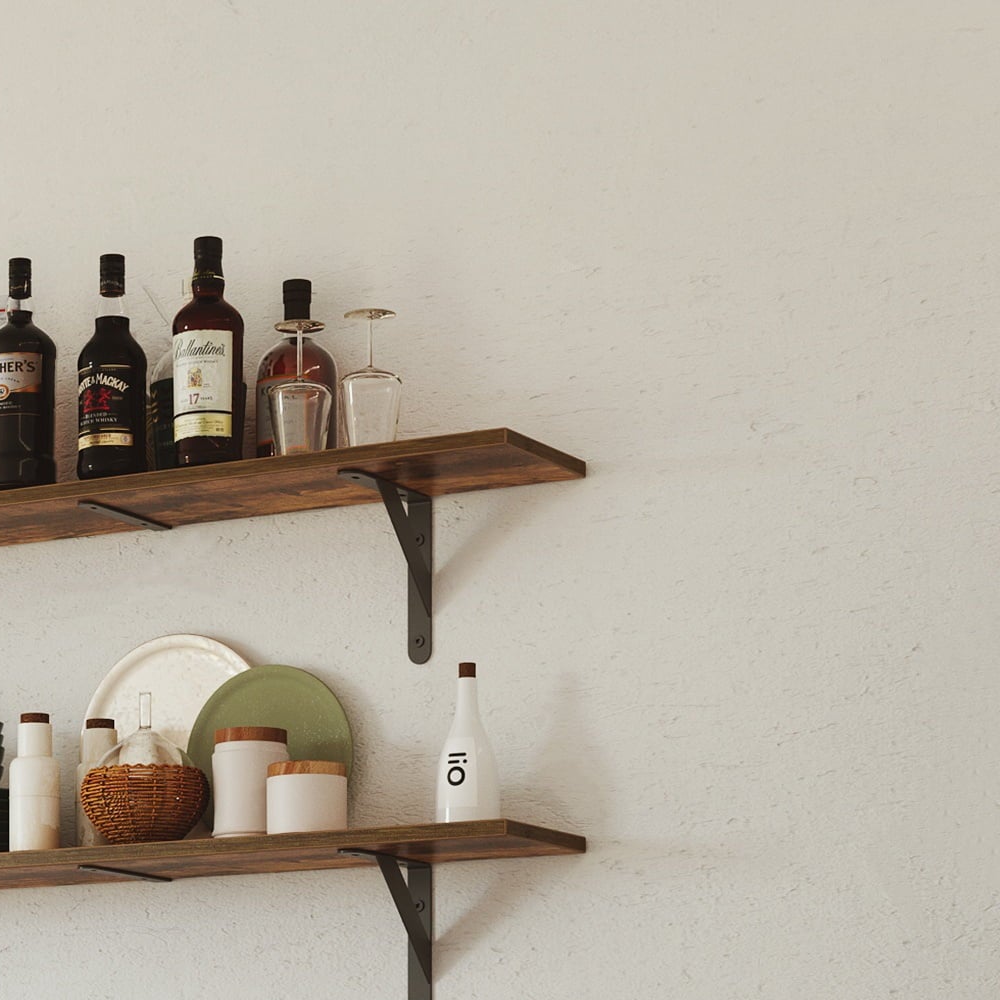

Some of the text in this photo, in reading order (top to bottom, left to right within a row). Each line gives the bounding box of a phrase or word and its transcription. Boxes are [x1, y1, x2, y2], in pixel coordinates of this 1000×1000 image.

[175, 339, 226, 361] Ballantine's
[96, 373, 129, 392] MACKAY
[188, 393, 200, 405] 17
